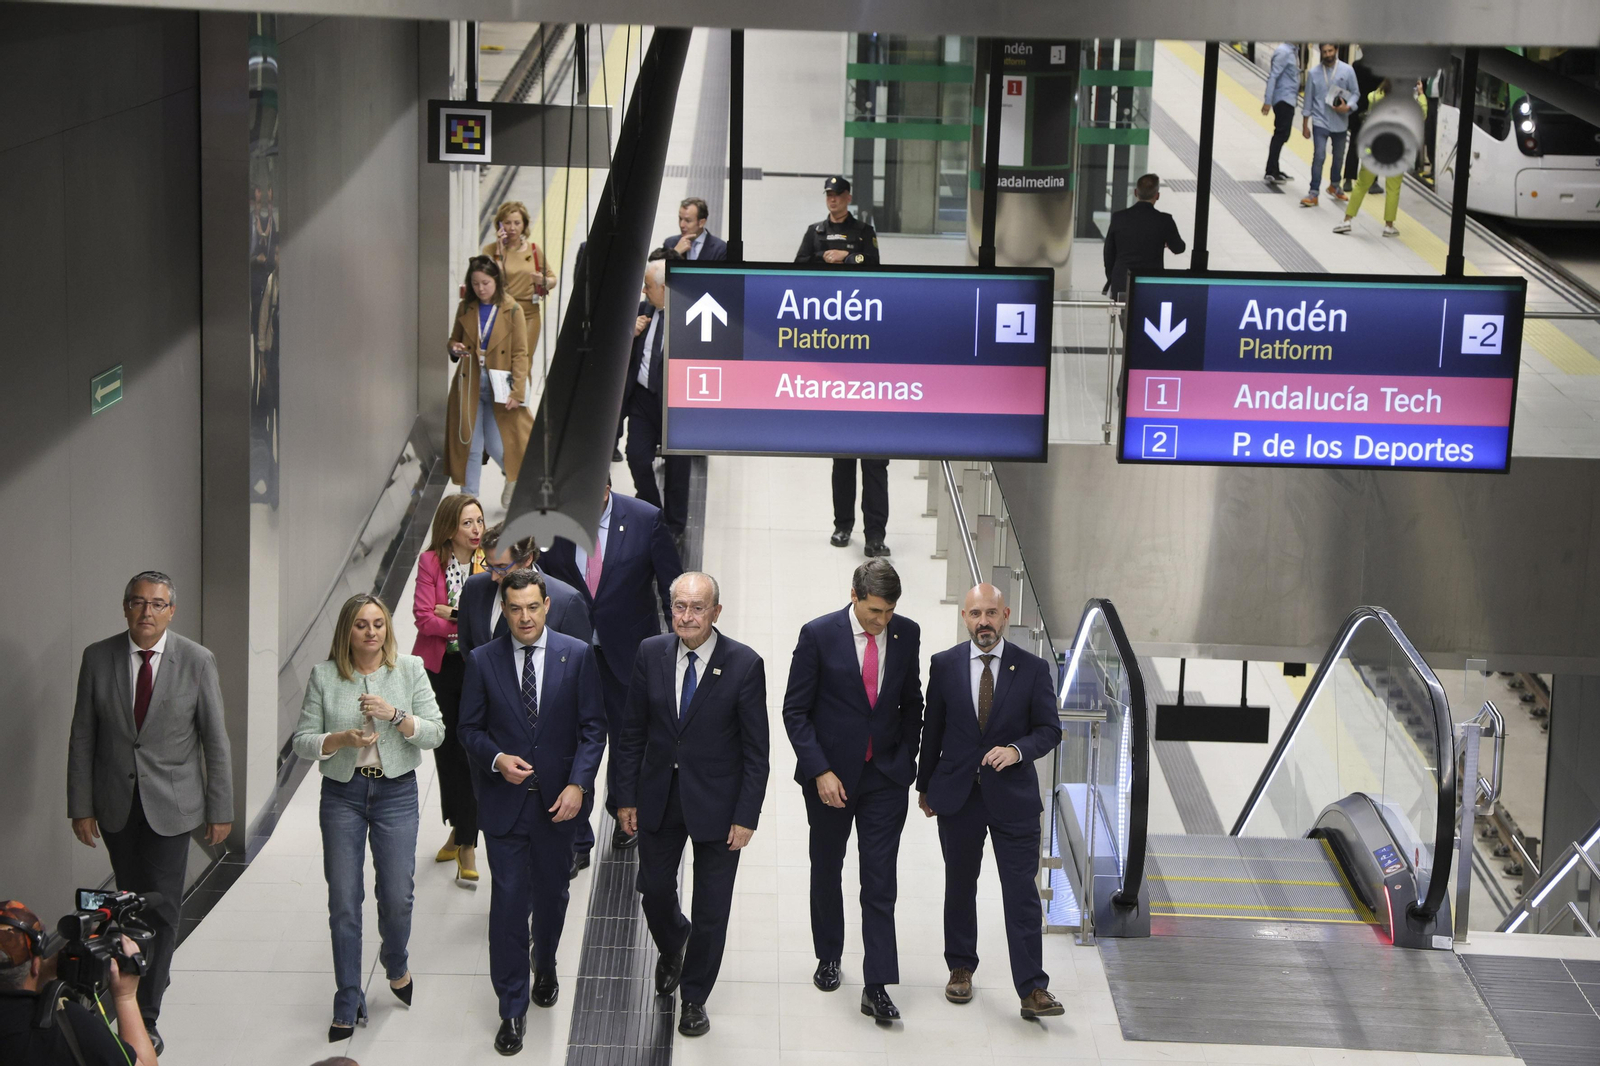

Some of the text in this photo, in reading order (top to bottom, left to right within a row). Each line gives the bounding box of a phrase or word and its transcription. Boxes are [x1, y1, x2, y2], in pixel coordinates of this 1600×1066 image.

[1004, 42, 1033, 55] ndén
[1053, 49, 1062, 61] -1
[1012, 82, 1017, 94] 1
[997, 176, 1065, 188] adalmedina
[776, 289, 883, 322] Andén
[1239, 298, 1347, 332] Andén
[1002, 310, 1028, 336] -1
[1468, 321, 1498, 348] -2
[777, 327, 870, 350] Platform
[1239, 337, 1333, 361] Platform
[698, 372, 924, 401] 1 Atarazanas
[1156, 383, 1442, 414] 1 Andalucía Tech
[1151, 431, 1474, 466] 2 P. de los Deportes
